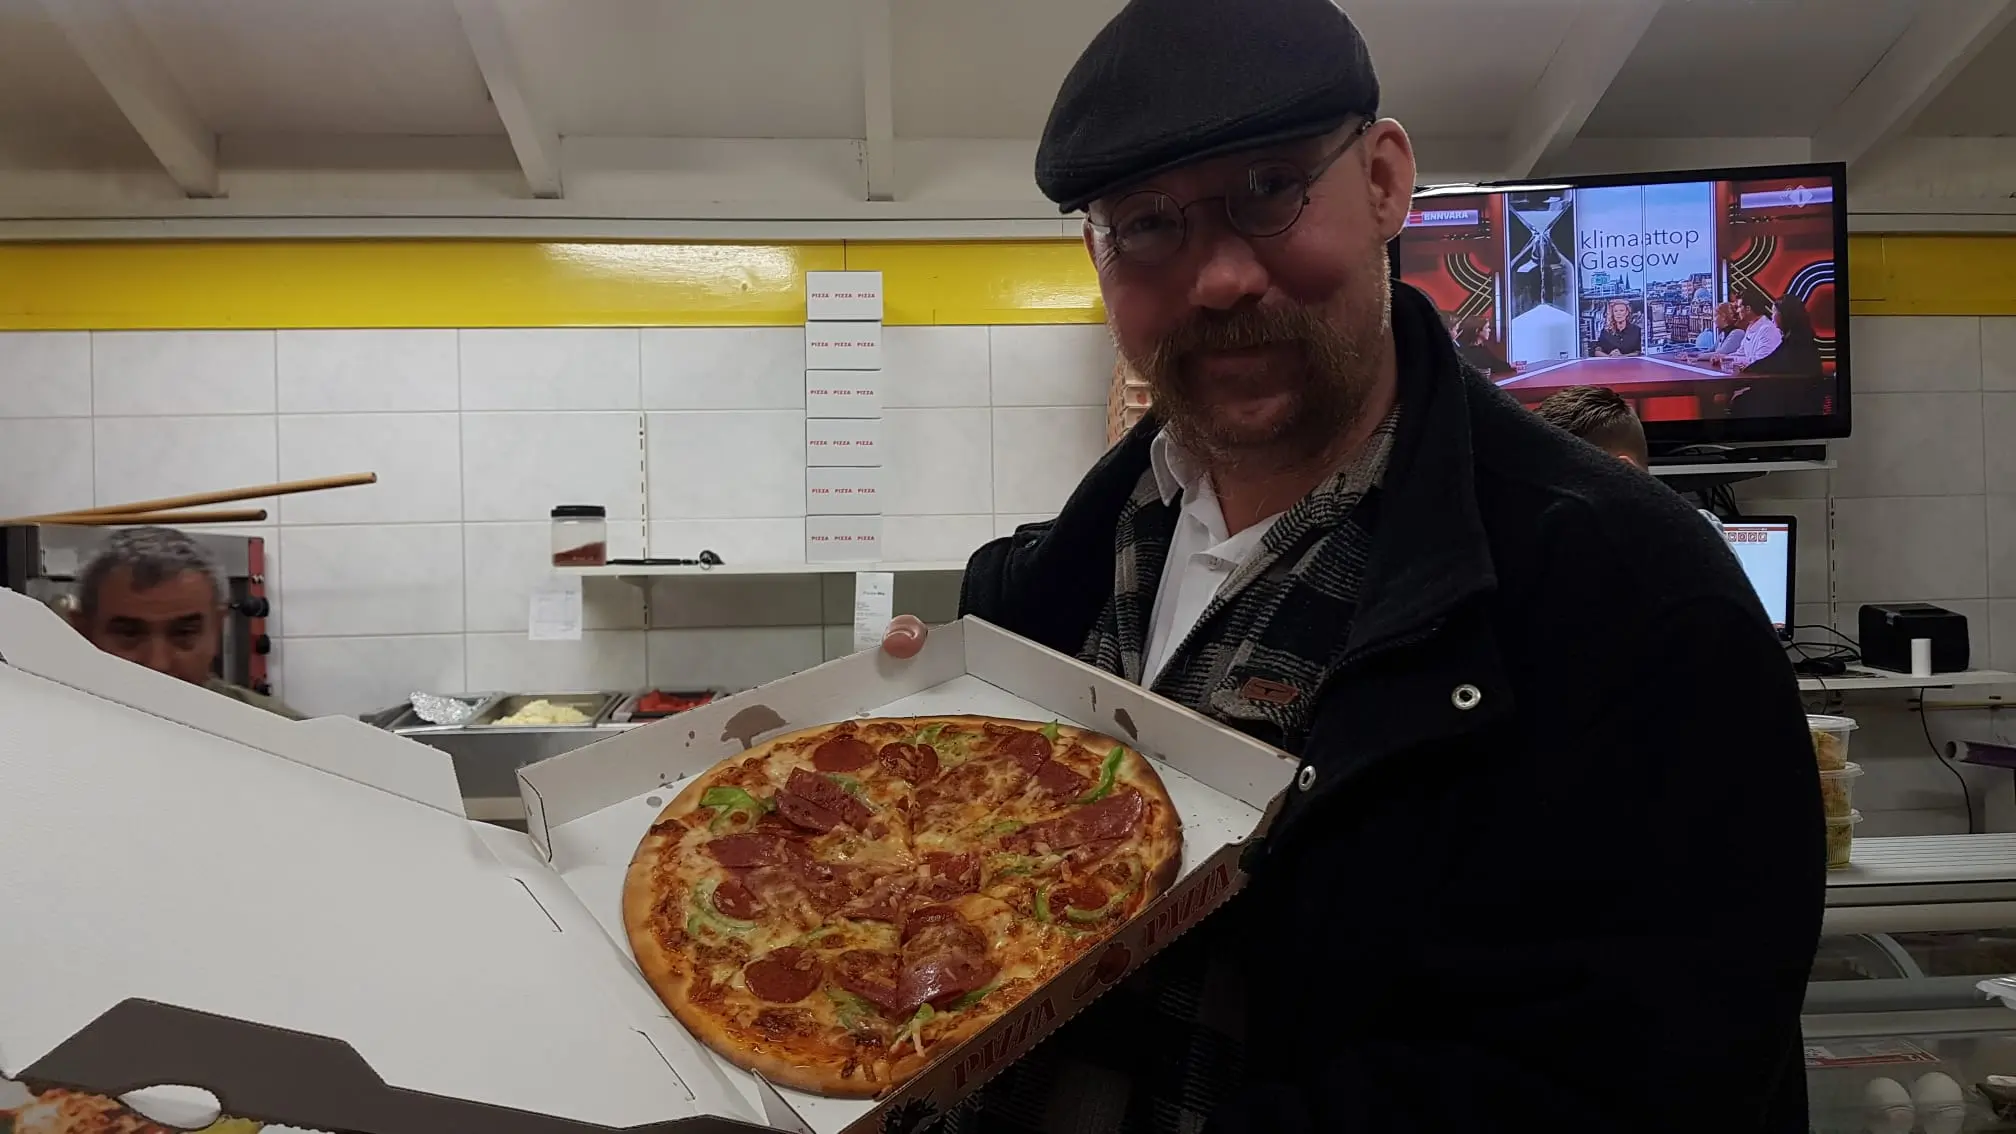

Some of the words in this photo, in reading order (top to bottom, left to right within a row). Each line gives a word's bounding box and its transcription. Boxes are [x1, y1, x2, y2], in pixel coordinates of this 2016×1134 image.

[1581, 229, 1699, 250] klimaattop
[1581, 249, 1680, 273] Glasgow
[809, 439, 827, 447] PIZZA
[833, 439, 850, 447] PIZZA
[856, 439, 873, 447] PIZZA
[811, 487, 829, 495] PIZZA
[834, 487, 852, 495] PIZZA
[857, 487, 875, 495] PIZZA
[952, 997, 1058, 1090] PIZZA
[1143, 862, 1230, 947] PIZZA
